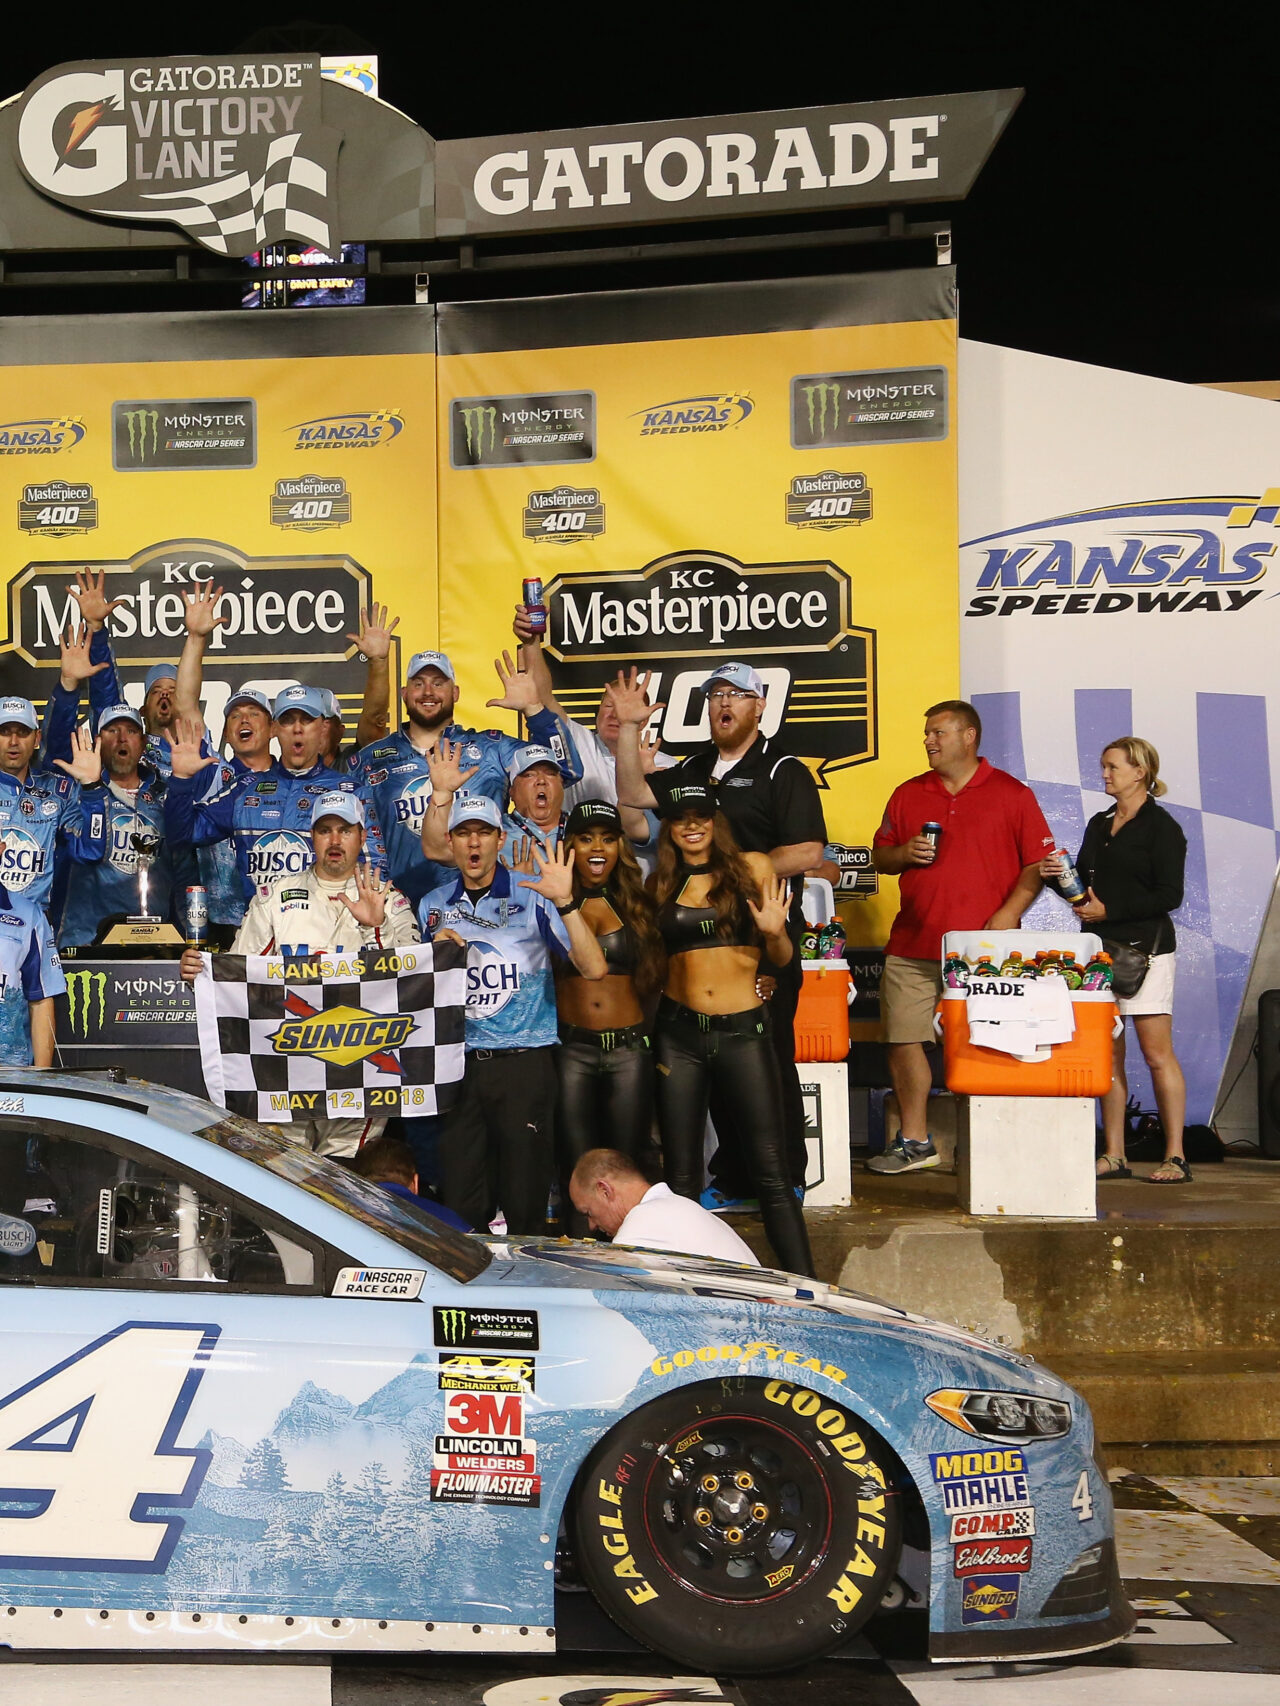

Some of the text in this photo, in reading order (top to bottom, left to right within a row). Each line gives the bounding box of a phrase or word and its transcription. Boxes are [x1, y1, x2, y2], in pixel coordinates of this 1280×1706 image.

[130, 64, 302, 93] GATORADE
[131, 96, 304, 138] VICTORY
[135, 140, 238, 180] LANE
[473, 114, 939, 215] GATORADE
[860, 401, 923, 410] ENERGY
[642, 406, 731, 427] KANSAS
[858, 410, 935, 422] NASCAR CUP SERIES
[297, 425, 383, 441] KANSAS
[512, 432, 584, 444] NASCAR CUP SERIES
[514, 424, 572, 433] ENERGY
[639, 423, 729, 436] SPEEDWAY
[174, 438, 245, 448] NASCAR CUP SERIES
[294, 440, 378, 450] SPEEDWAY
[28, 488, 88, 503] Masterpiece
[280, 481, 341, 496] Masterpiece
[796, 478, 861, 495] Masterpiece
[289, 501, 333, 518] 400
[532, 492, 595, 508] Masterpiece
[805, 497, 853, 517] 400
[36, 507, 80, 524] 400
[541, 512, 586, 531] 400
[975, 529, 1278, 591] KANSAS
[162, 562, 215, 583] KC
[670, 569, 715, 589] KC
[964, 589, 1264, 617] SPEEDWAY
[561, 581, 827, 646] Masterpiece
[0, 913, 23, 927] Ford
[267, 954, 417, 979] KANSAS 400
[127, 1012, 184, 1021] NASCAR CUP
[280, 1017, 407, 1048] SUNOCO
[270, 1088, 424, 1110] MAY 12, 2018
[3, 1240, 23, 1248] LIGHT
[363, 1272, 412, 1283] NASCAR
[346, 1284, 407, 1294] RACE CAR
[651, 1342, 847, 1383] GOODYEAR
[441, 1377, 498, 1391] MECHANIX
[448, 1393, 521, 1435] 3M
[440, 1439, 517, 1454] LINCOLN
[456, 1457, 525, 1470] WELDERS
[936, 1450, 1022, 1479] MOOG
[436, 1473, 532, 1497] FLOWMASTER
[943, 1476, 1027, 1508] MAHLE
[764, 1380, 886, 1613] GOODYEAR
[1072, 1470, 1093, 1522] 4
[954, 1513, 1014, 1536] COMP
[996, 1526, 1027, 1535] CAMS
[599, 1479, 659, 1605] EAGLE
[956, 1546, 1029, 1570] Edelbrock
[964, 1592, 1015, 1608] SUNOCO
